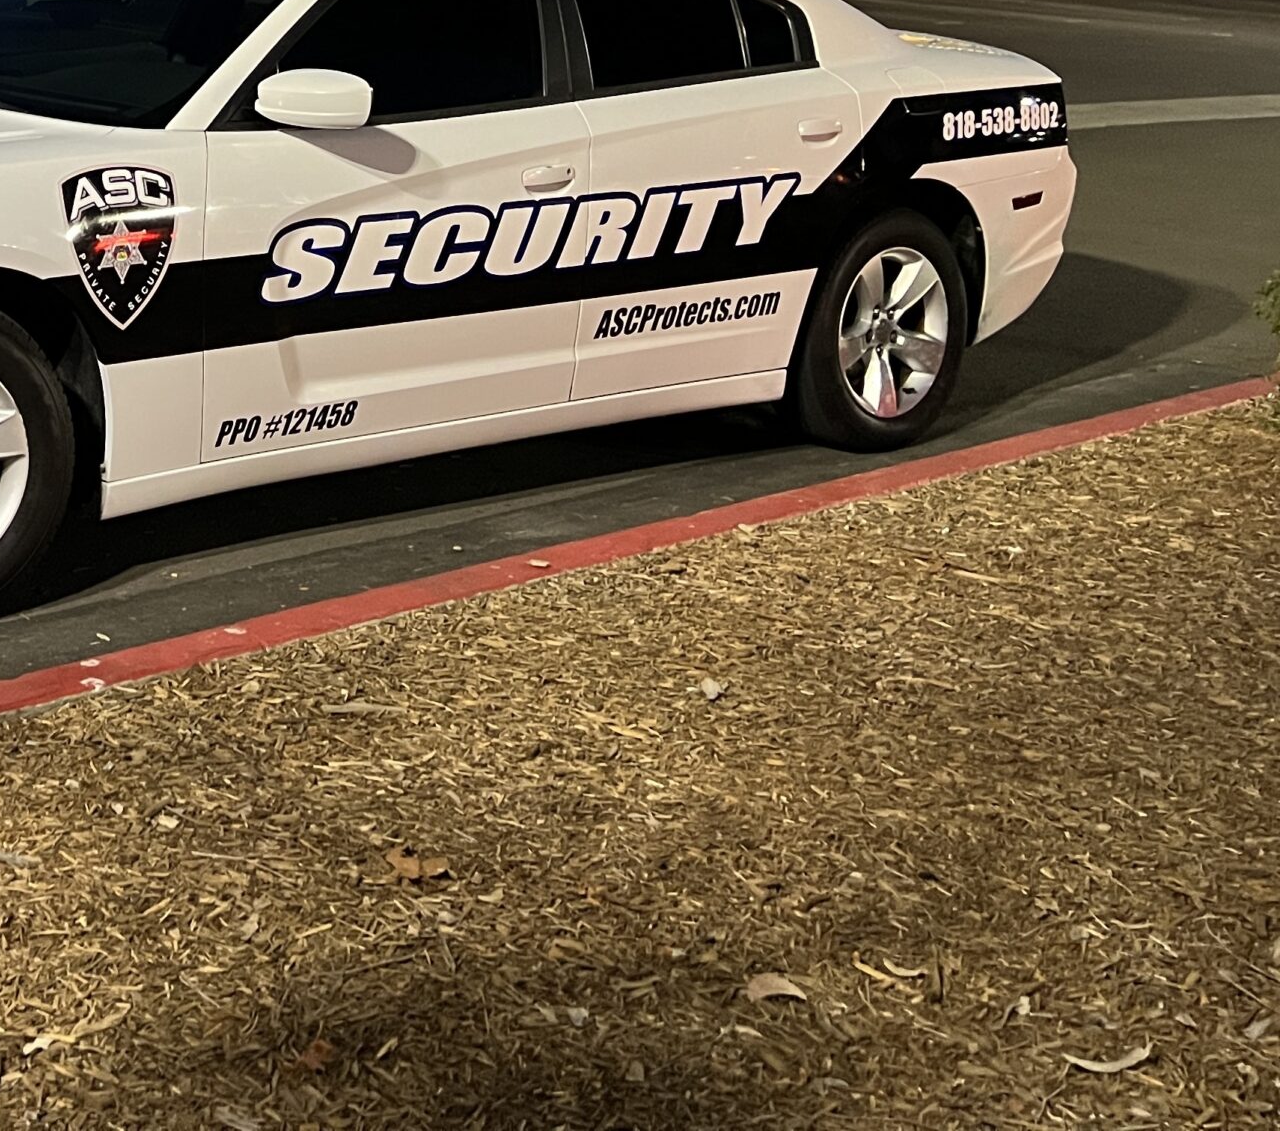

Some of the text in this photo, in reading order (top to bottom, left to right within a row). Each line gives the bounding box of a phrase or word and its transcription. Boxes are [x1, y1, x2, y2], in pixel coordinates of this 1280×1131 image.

[942, 101, 1059, 141] 818-538-8802
[69, 168, 170, 222] ASC
[258, 173, 801, 304] SECURITY
[78, 252, 117, 311] PRIVATE
[127, 240, 169, 311] SECURITY
[593, 291, 782, 340] ASCProtects.com
[214, 400, 359, 448] PPO #121458
